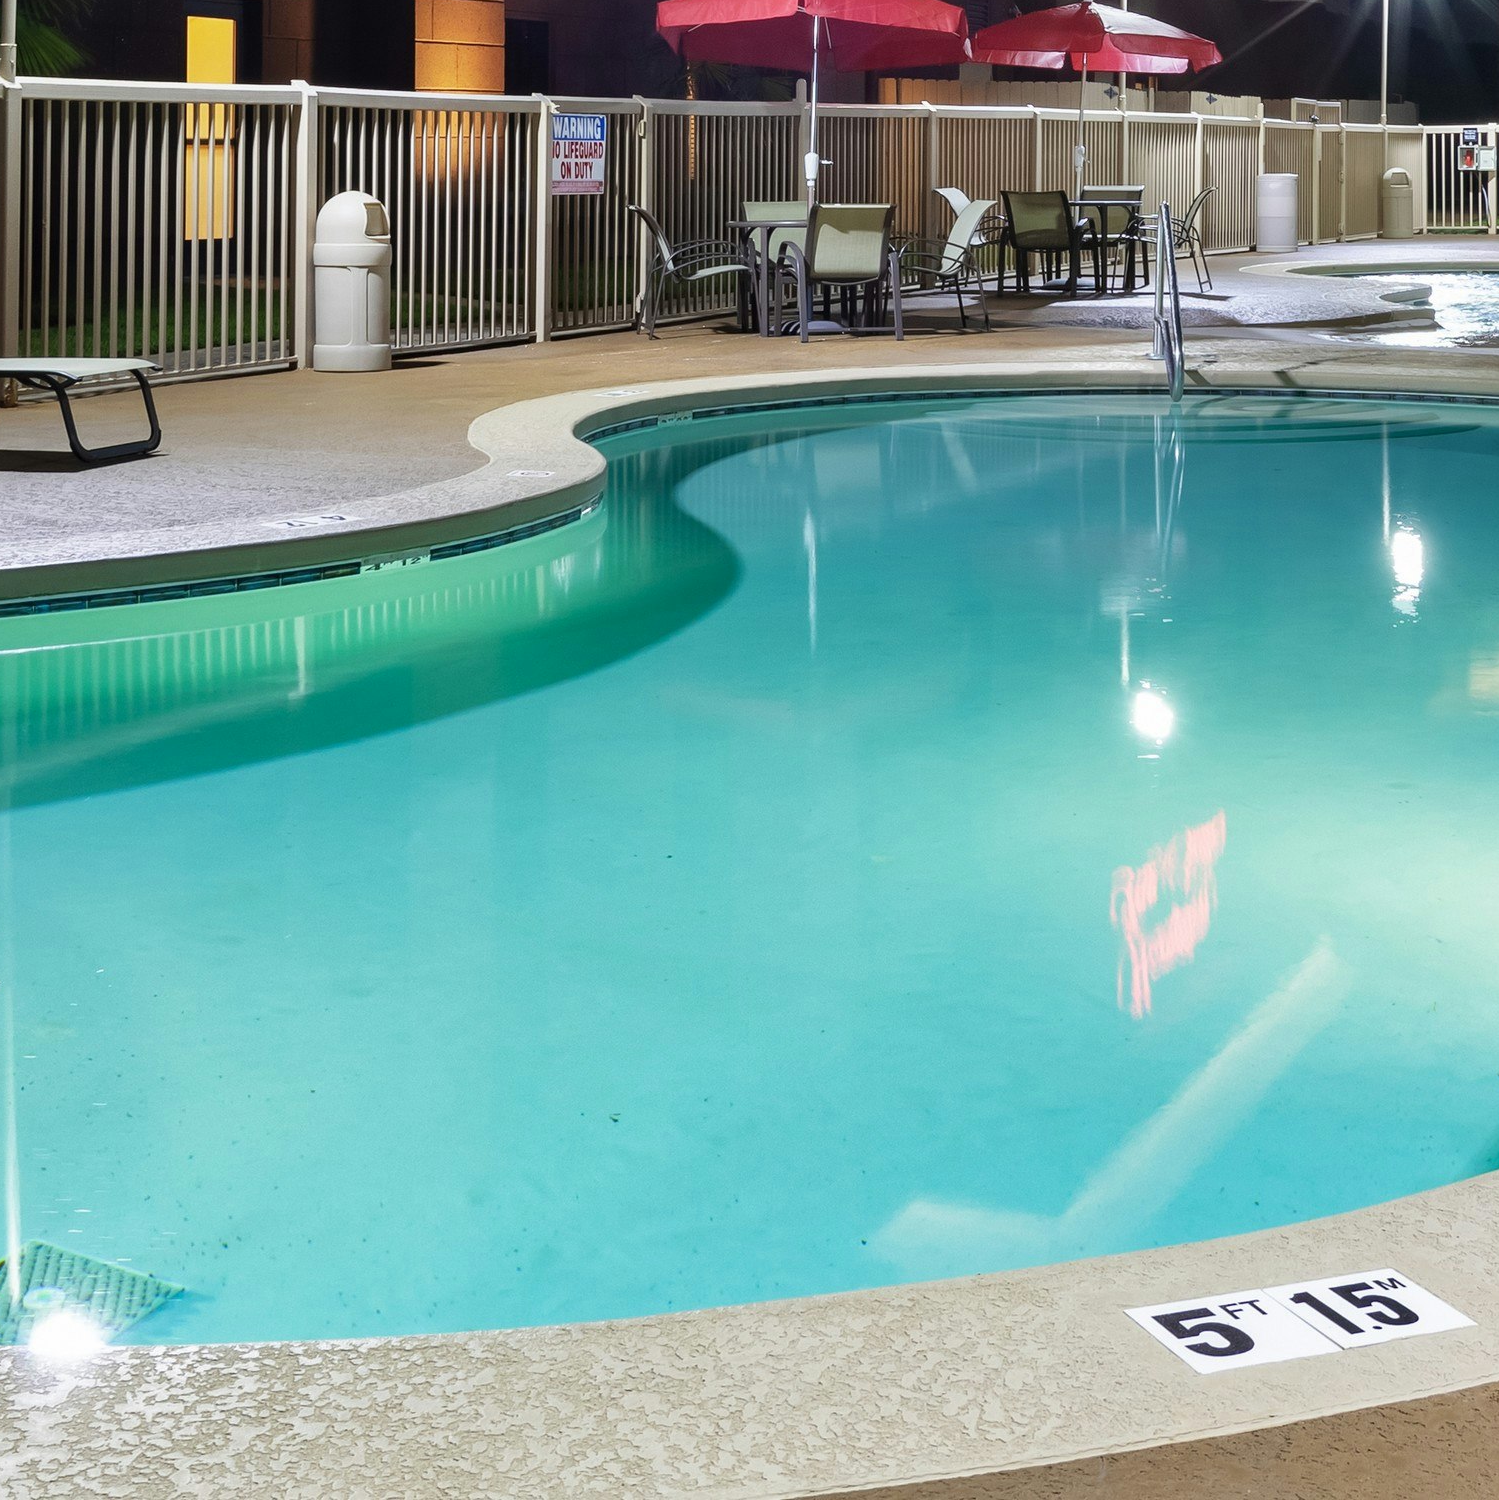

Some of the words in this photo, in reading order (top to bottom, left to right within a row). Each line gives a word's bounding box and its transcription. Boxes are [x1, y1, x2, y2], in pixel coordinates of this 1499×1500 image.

[553, 116, 602, 139] WARNING
[563, 141, 604, 159] LIFEGUARD
[560, 161, 571, 179] ON
[574, 161, 594, 179] DUTY
